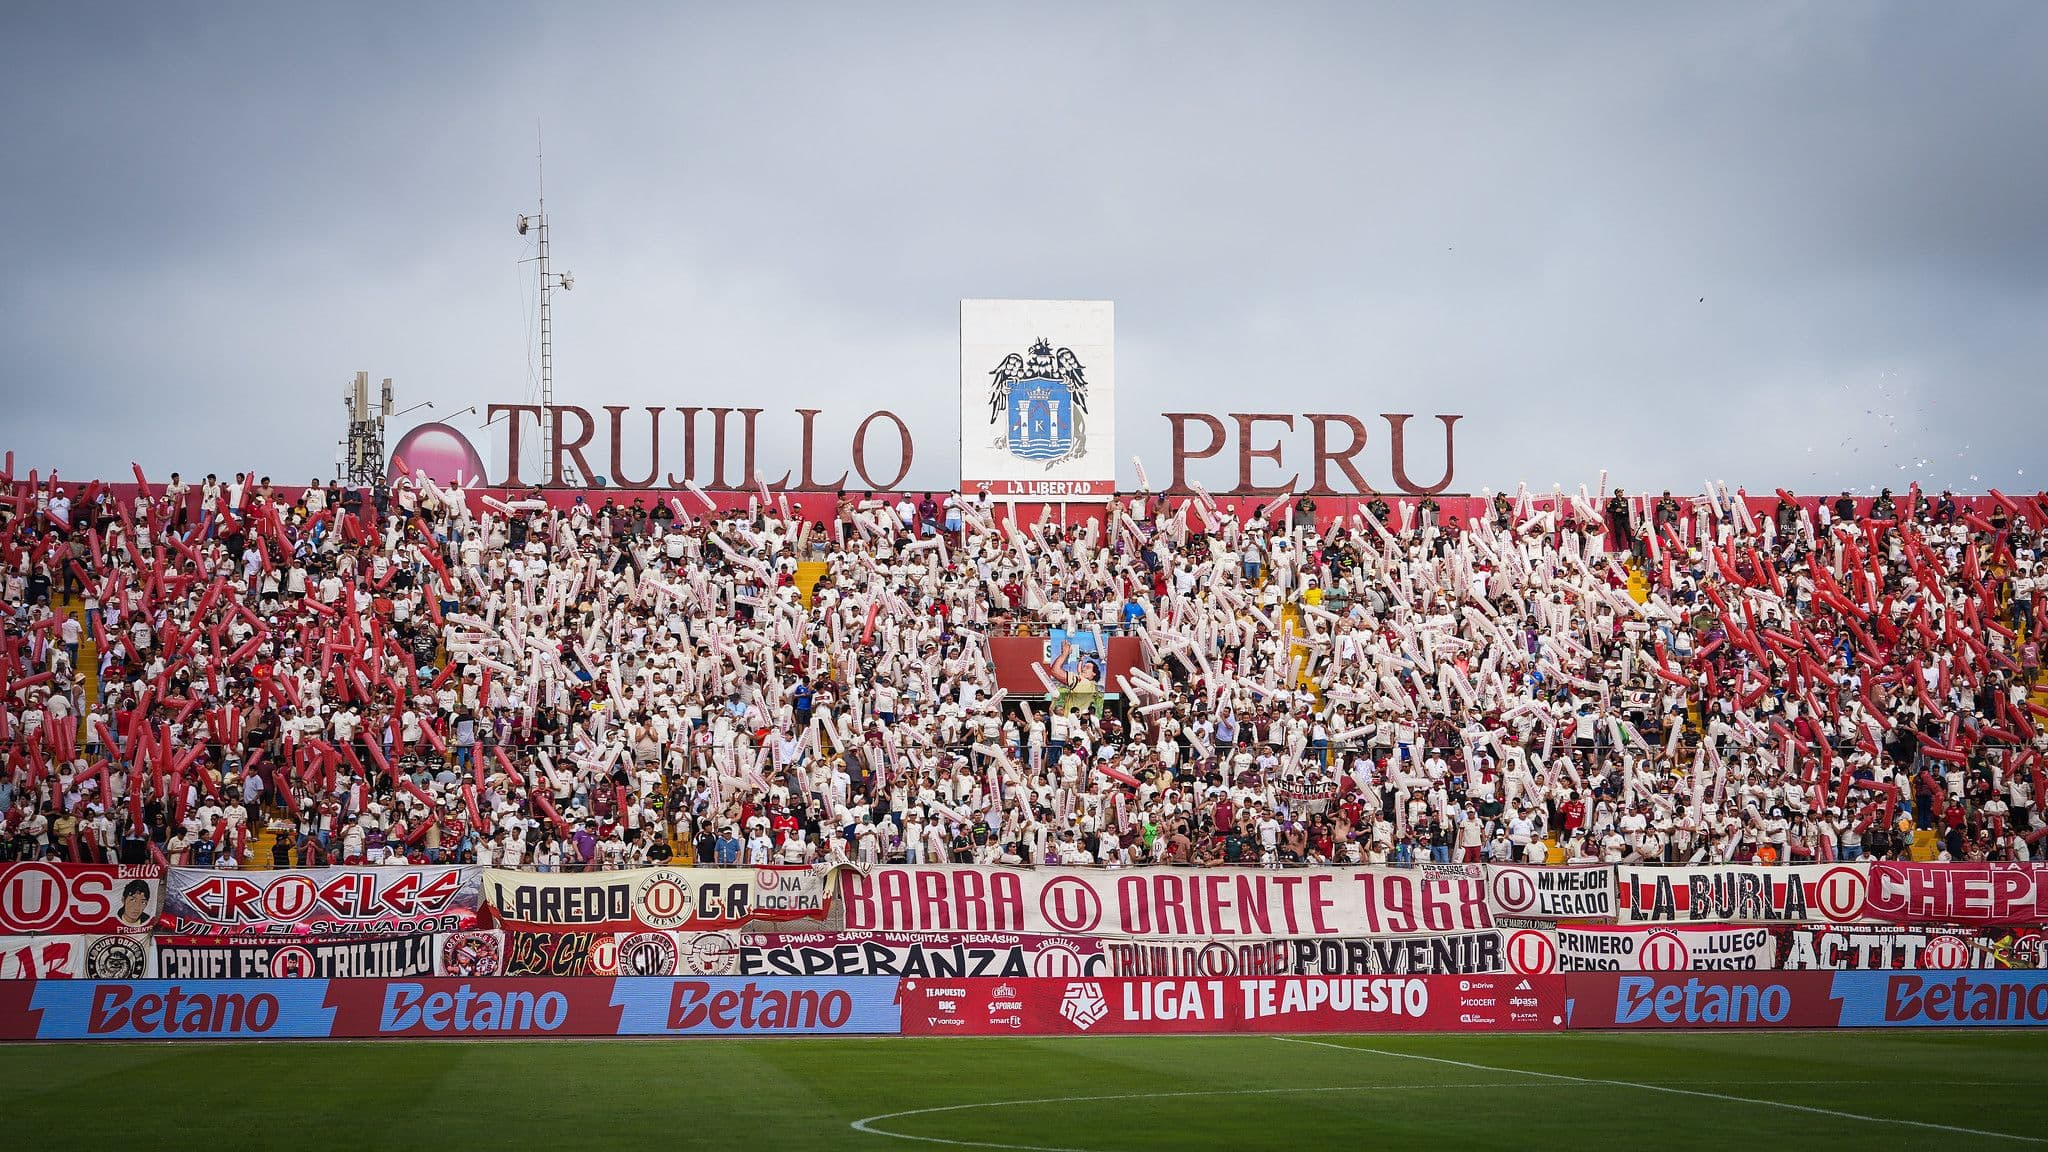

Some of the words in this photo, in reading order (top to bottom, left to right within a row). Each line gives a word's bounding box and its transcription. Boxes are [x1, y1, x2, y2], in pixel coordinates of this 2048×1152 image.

[487, 404, 914, 491] TRUJILLO
[1160, 412, 1464, 495] PERU
[1007, 481, 1024, 494] LA
[1028, 481, 1091, 494] LIBERTAD
[182, 869, 465, 925] CRUELES
[1538, 871, 1556, 890] MI
[1557, 870, 1608, 891] MEJOR
[1630, 873, 1676, 921] LA
[1689, 872, 1807, 920] BURLA
[494, 882, 630, 923] LAREDO
[756, 895, 820, 910] LOCURA
[840, 869, 1025, 931] BARRA
[1117, 874, 1339, 935] ORIENTE
[1540, 892, 1609, 915] LEGADO
[779, 933, 825, 943] EDWARD
[837, 931, 873, 942] SARCO
[885, 932, 950, 944] MANCHITAS
[961, 934, 1020, 944] NEGRASHO
[1035, 937, 1080, 954] TRUJILLO
[1558, 931, 1634, 954] PRIMERO
[1829, 925, 1872, 933] MISMOS
[317, 934, 431, 978] TRUJILLO
[740, 942, 1028, 977] ESPERANZA
[1291, 931, 1505, 975] PORVENIR
[87, 985, 280, 1034] Betano
[379, 983, 569, 1032] Betano
[666, 981, 853, 1030] Betano
[938, 1001, 956, 1010] BIG
[1614, 976, 1792, 1024] Betano
